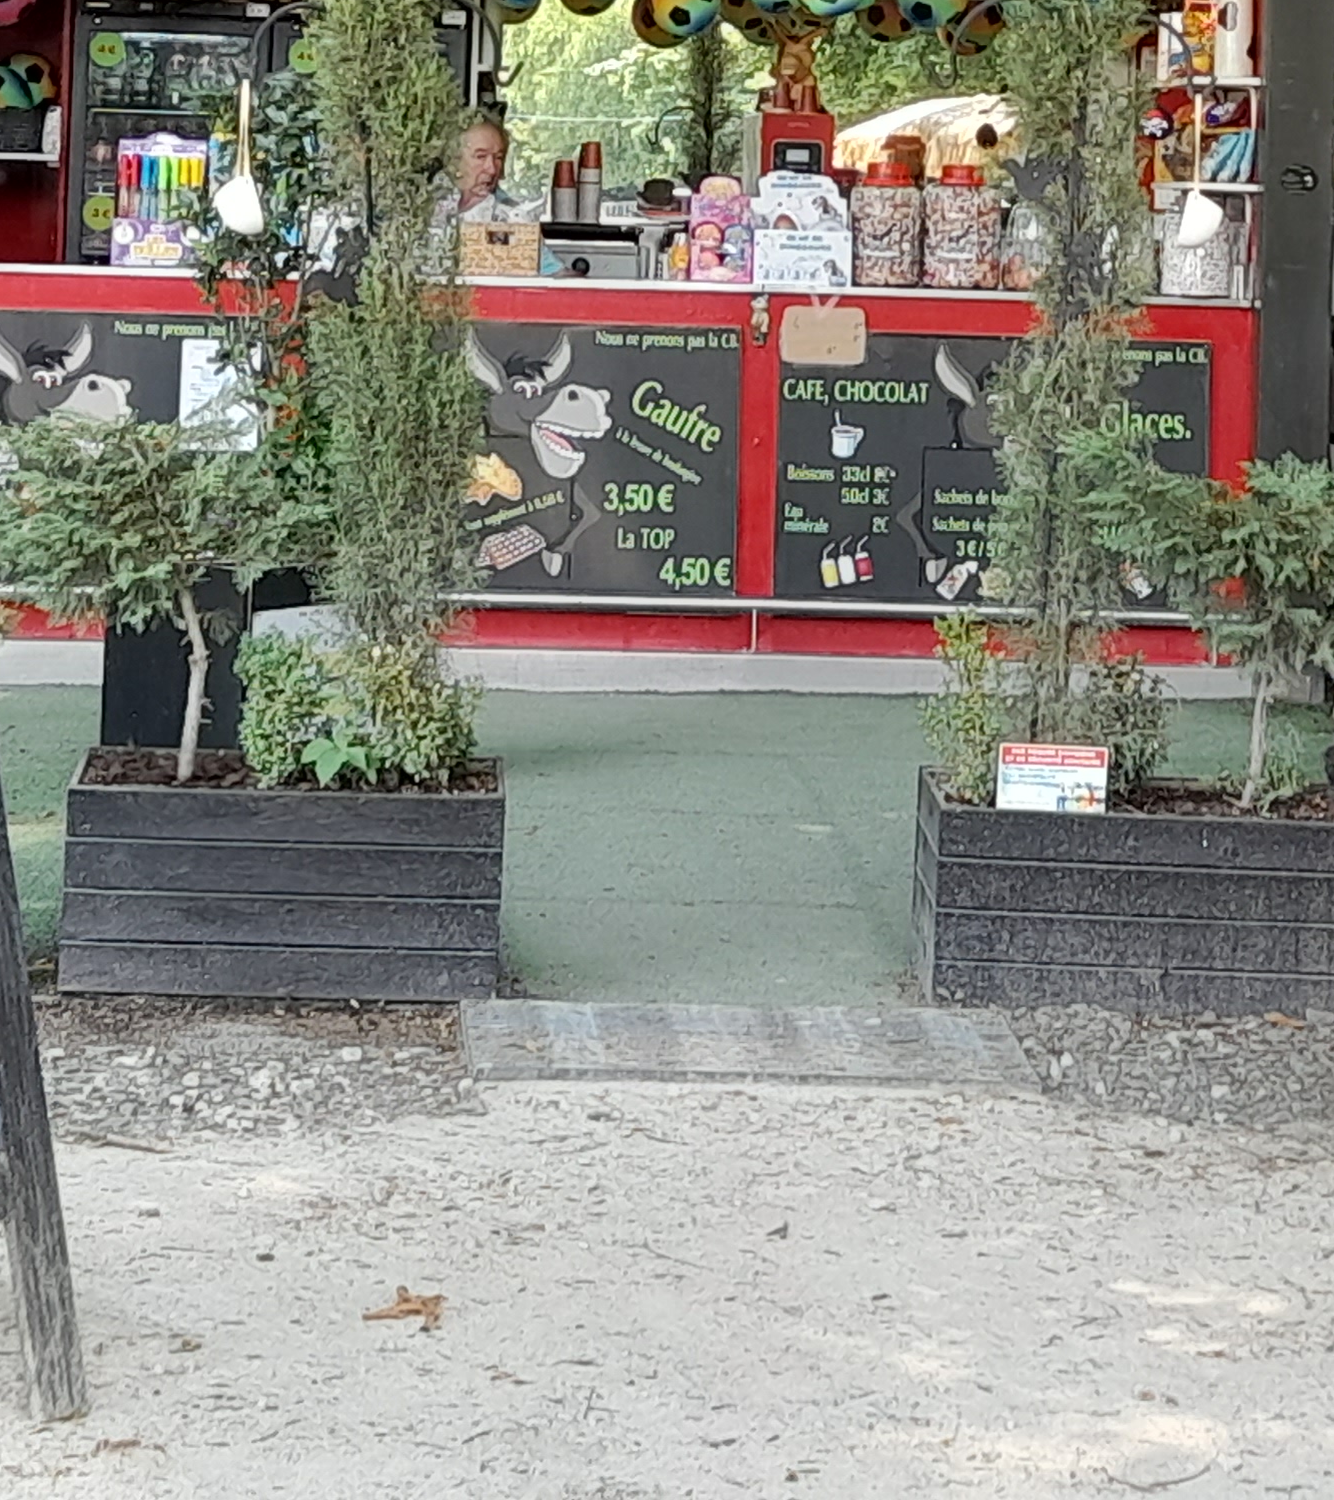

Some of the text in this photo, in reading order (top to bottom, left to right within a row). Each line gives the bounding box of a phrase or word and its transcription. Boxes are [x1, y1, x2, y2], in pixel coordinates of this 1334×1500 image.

[594, 330, 624, 346] Nous
[642, 334, 684, 351] prenons
[687, 336, 705, 351] pas
[833, 379, 930, 405] CHOCOLAT
[631, 380, 723, 452] Gaufre
[603, 483, 675, 517] 3,50 €
[617, 528, 676, 550] La TOP
[659, 557, 732, 591] 4,50 €
